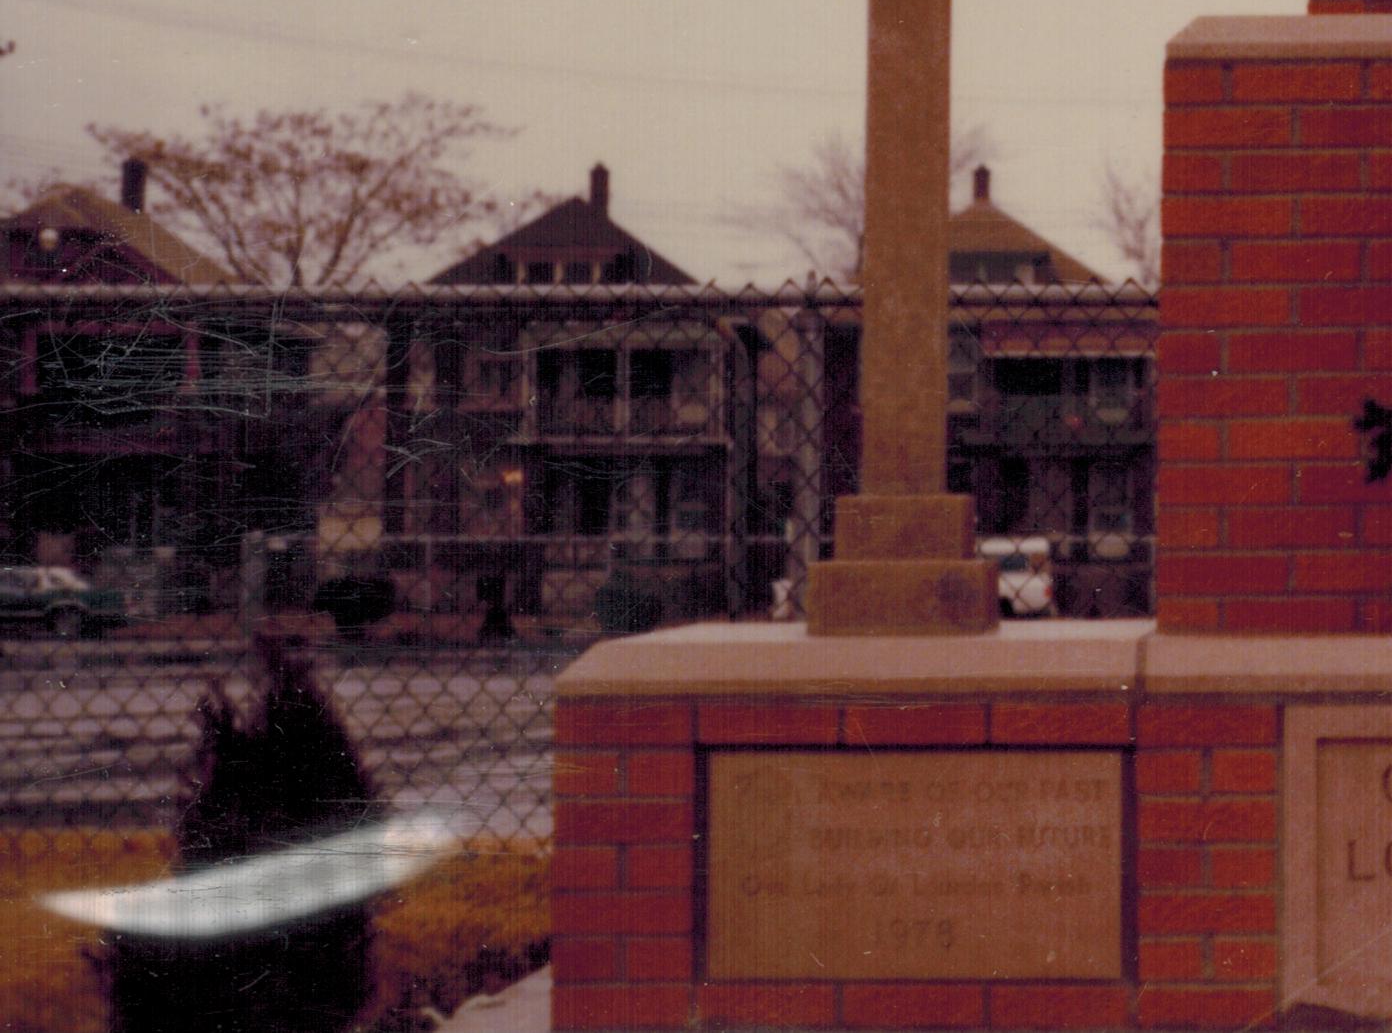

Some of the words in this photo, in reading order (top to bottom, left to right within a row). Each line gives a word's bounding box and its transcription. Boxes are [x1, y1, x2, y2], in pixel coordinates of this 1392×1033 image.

[926, 780, 965, 803] OF
[1038, 778, 1107, 802] PAST
[947, 826, 1002, 850] OUR
[1014, 825, 1112, 850] FUTURE
